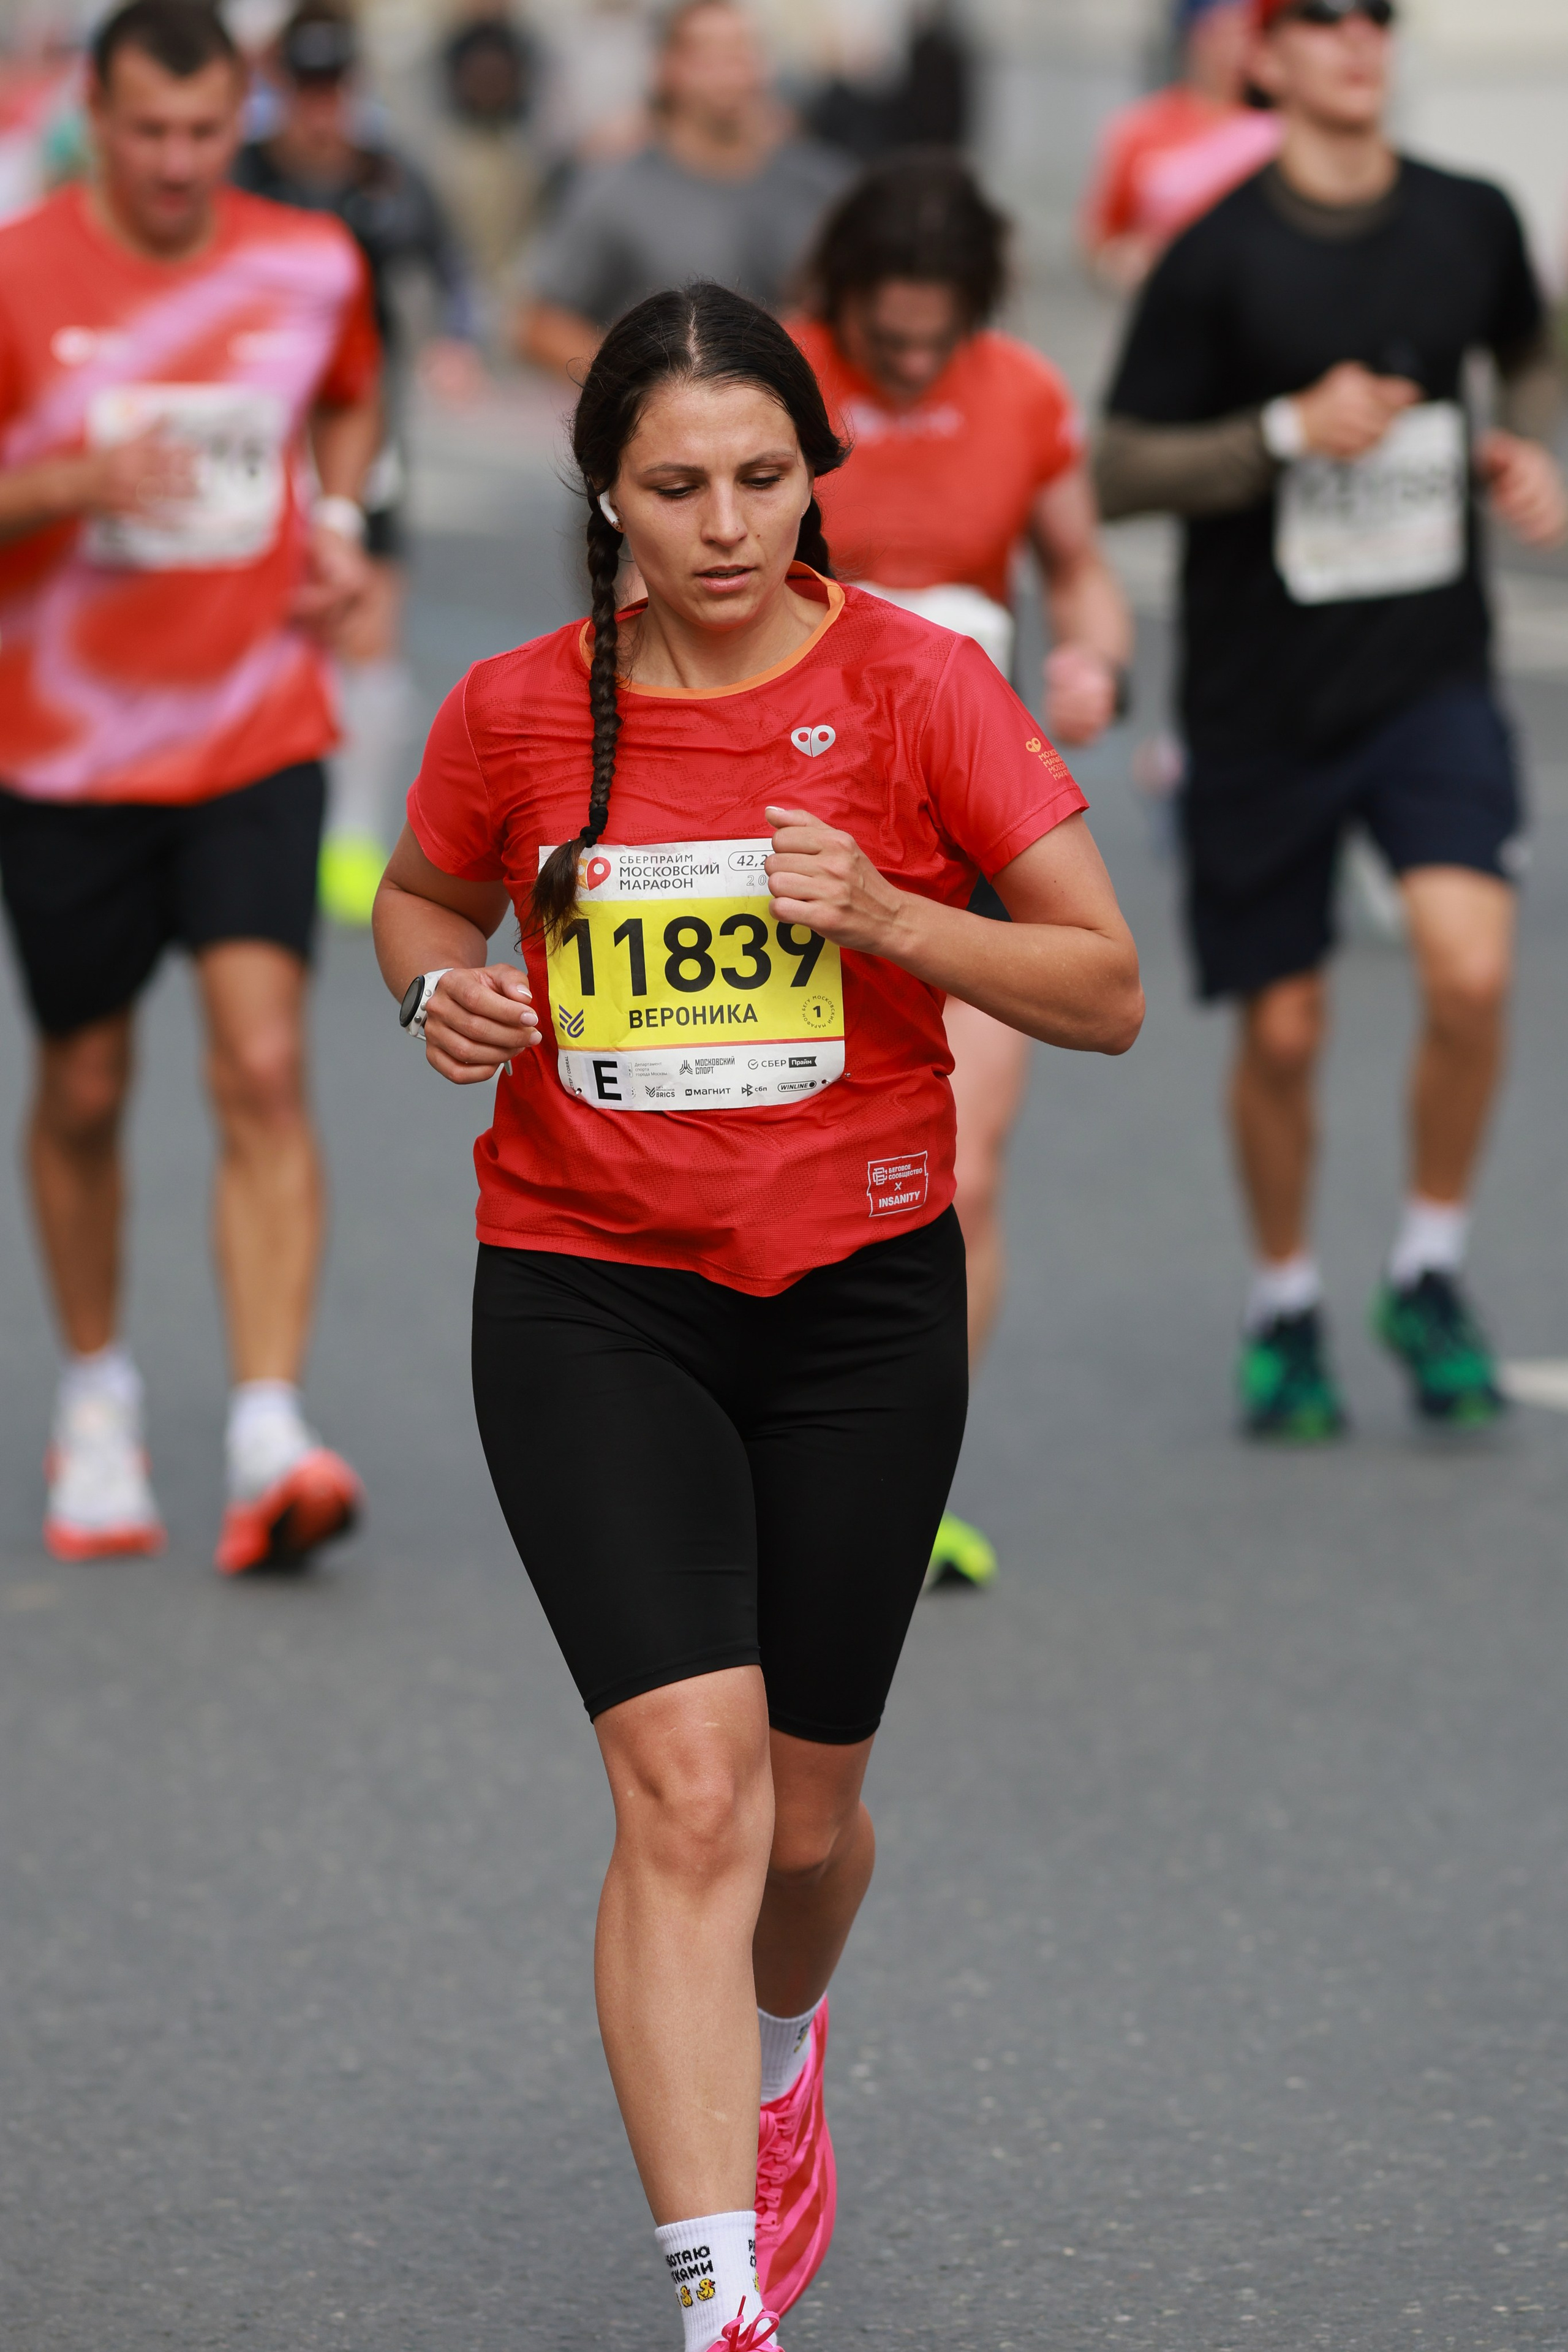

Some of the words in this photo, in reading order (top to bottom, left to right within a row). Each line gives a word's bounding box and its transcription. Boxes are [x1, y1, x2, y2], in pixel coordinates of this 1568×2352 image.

[619, 853, 693, 864] СБЕРПРАЙМ
[736, 854, 768, 867] 42,2
[619, 862, 720, 877] МОСКОВСКИЙ
[619, 878, 693, 891] МАРАФОН
[562, 913, 826, 997] 11839
[629, 1003, 758, 1029] ВЕРОНИКА
[812, 995, 835, 1024] МОСКОВСКИЙ
[813, 1005, 821, 1018] 1
[802, 1013, 826, 1028] МАРАФОН
[695, 1056, 736, 1067] МОСКОВСКИЙ
[695, 1066, 714, 1075] СПОРТ
[592, 1060, 622, 1101] E
[888, 1164, 911, 1174] БЕГОВОЕ
[888, 1167, 923, 1180] СООБЩЕСТВО
[878, 1191, 921, 1208] INSANITY
